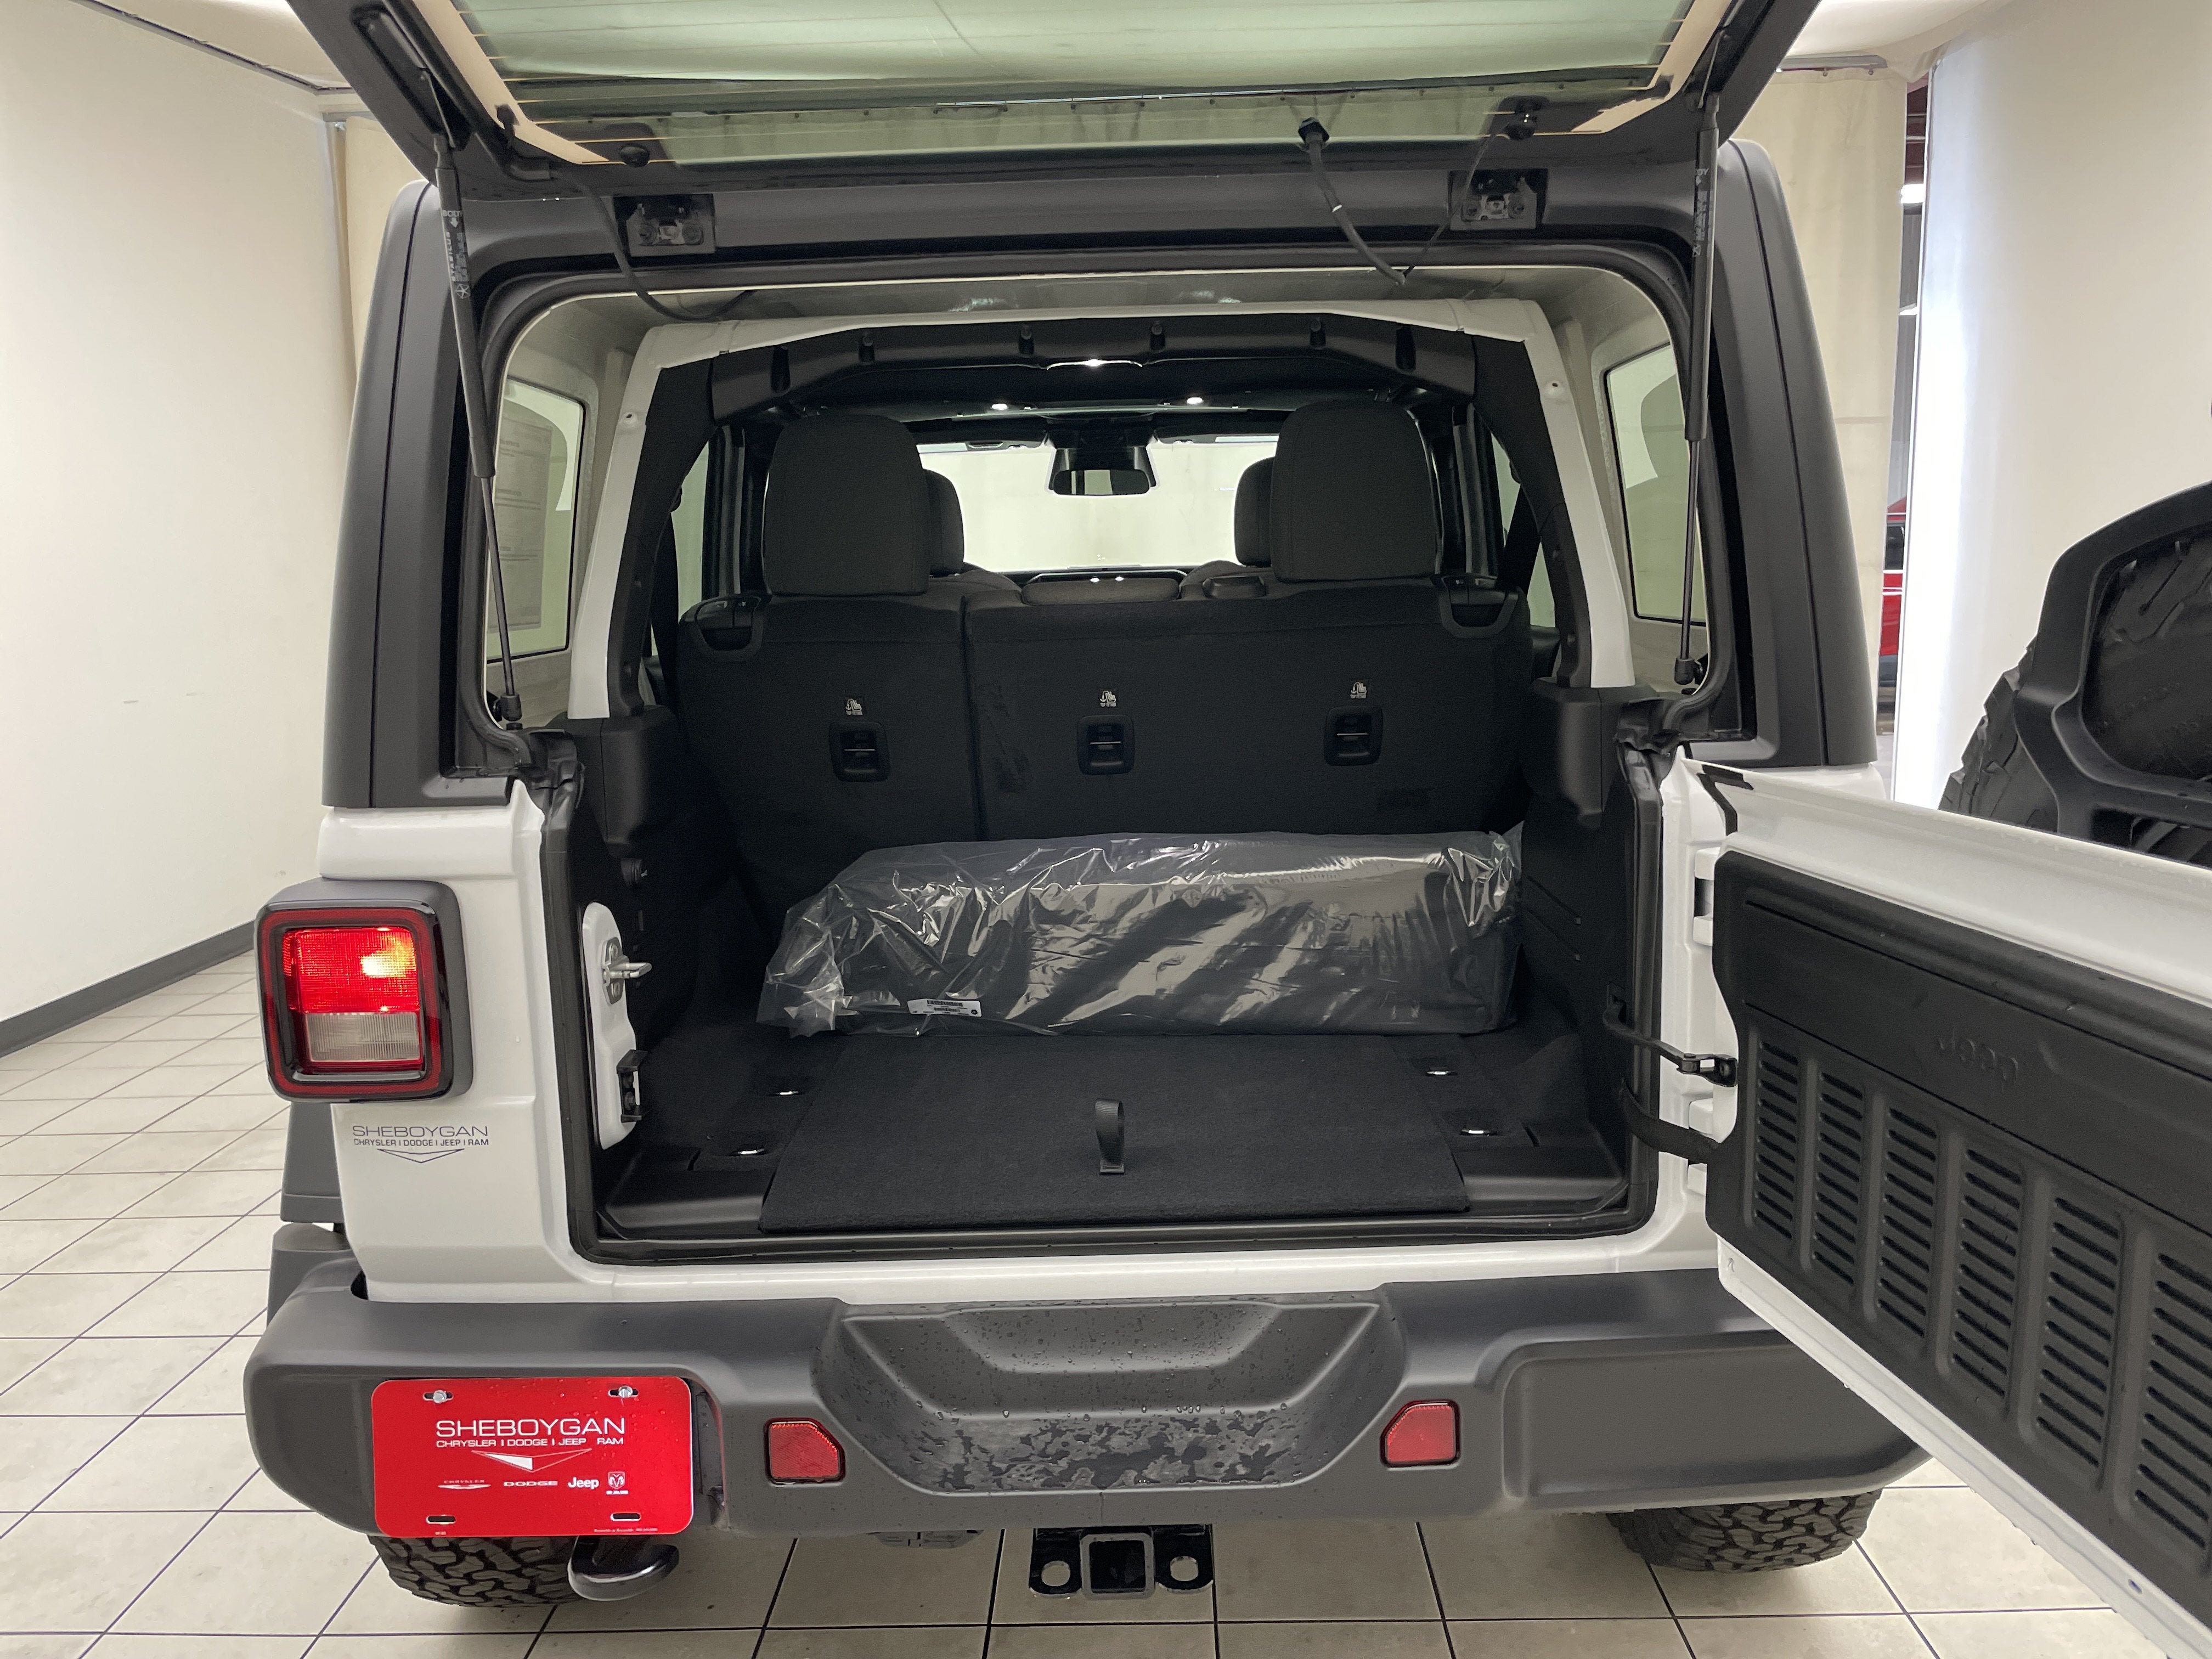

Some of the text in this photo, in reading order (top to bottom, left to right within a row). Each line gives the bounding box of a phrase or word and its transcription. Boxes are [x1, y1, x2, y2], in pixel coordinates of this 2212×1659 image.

[352, 1125, 488, 1137] SHEBOYGAN
[353, 1138, 396, 1147] CHRYSLER
[436, 1417, 625, 1437] SHEBOYGAN
[436, 1437, 624, 1448] CHRYSLER DODGE JEEP RAM
[568, 1476, 600, 1490] Jeep
